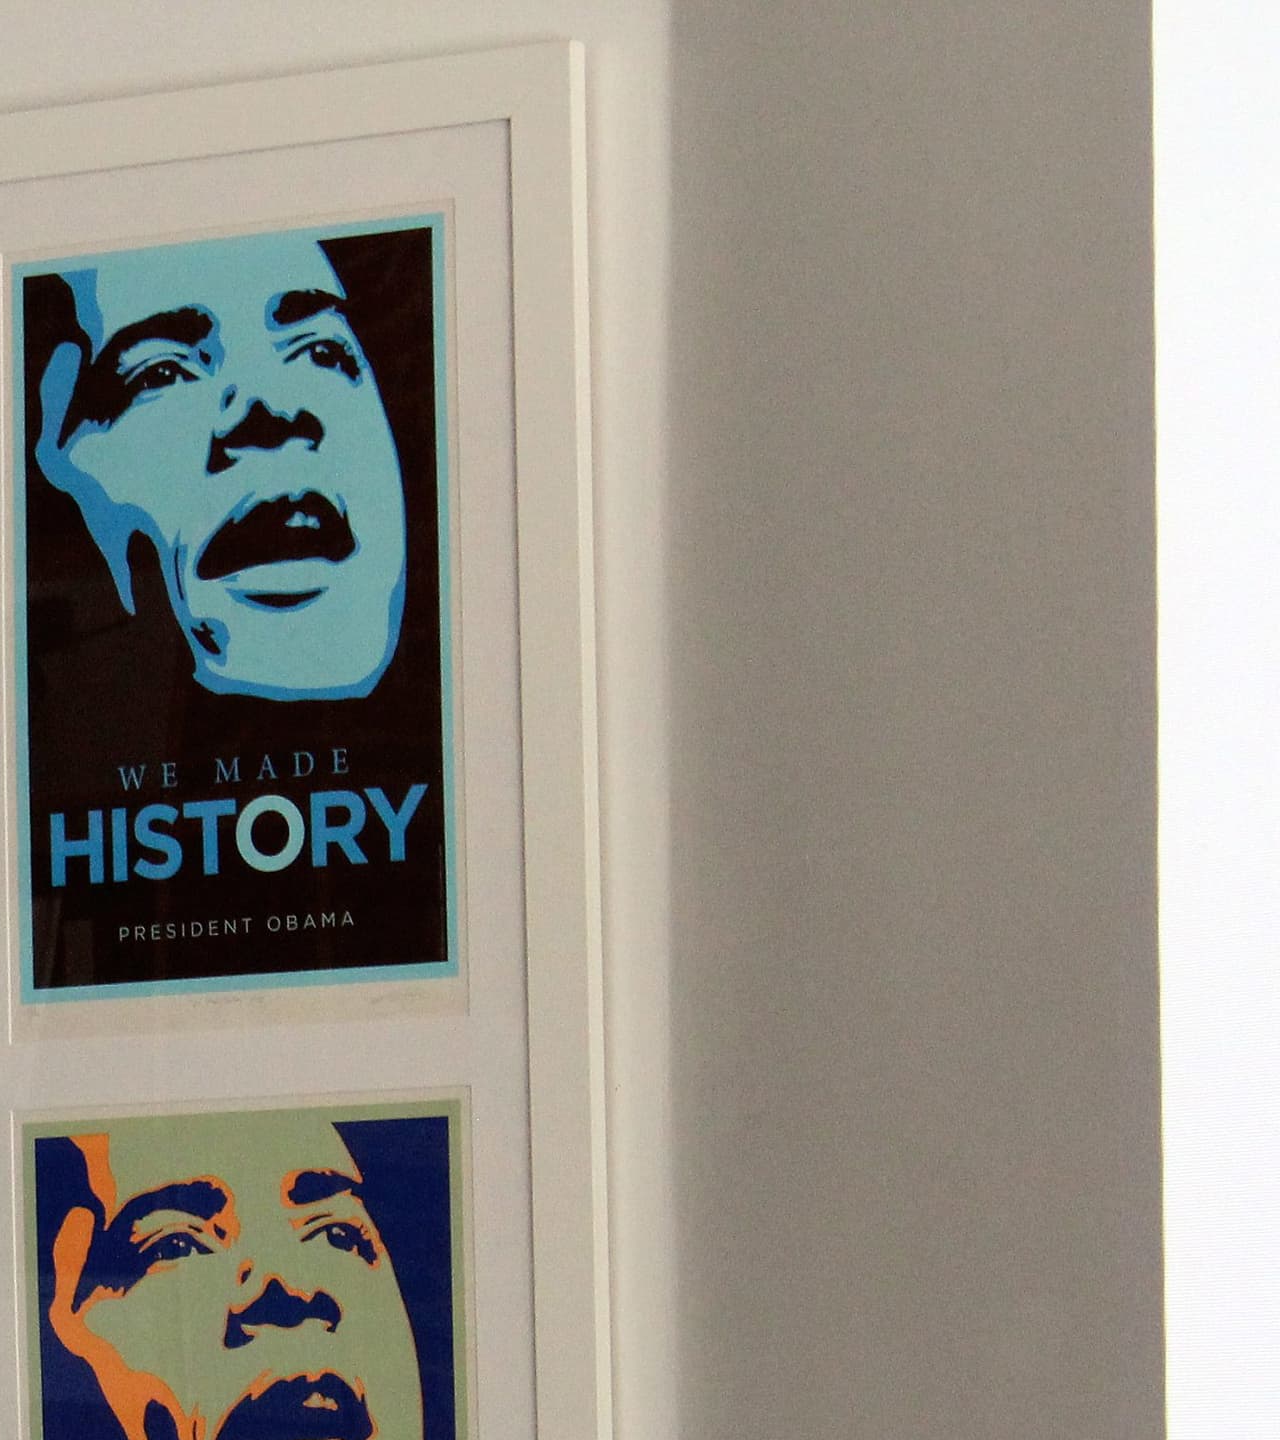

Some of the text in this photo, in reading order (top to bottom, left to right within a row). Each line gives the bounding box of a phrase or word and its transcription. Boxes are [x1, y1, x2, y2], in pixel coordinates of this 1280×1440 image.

[117, 747, 350, 792] WE MADE
[48, 783, 430, 888] HISTORY
[118, 910, 355, 942] PRESIDENT OBAMA
